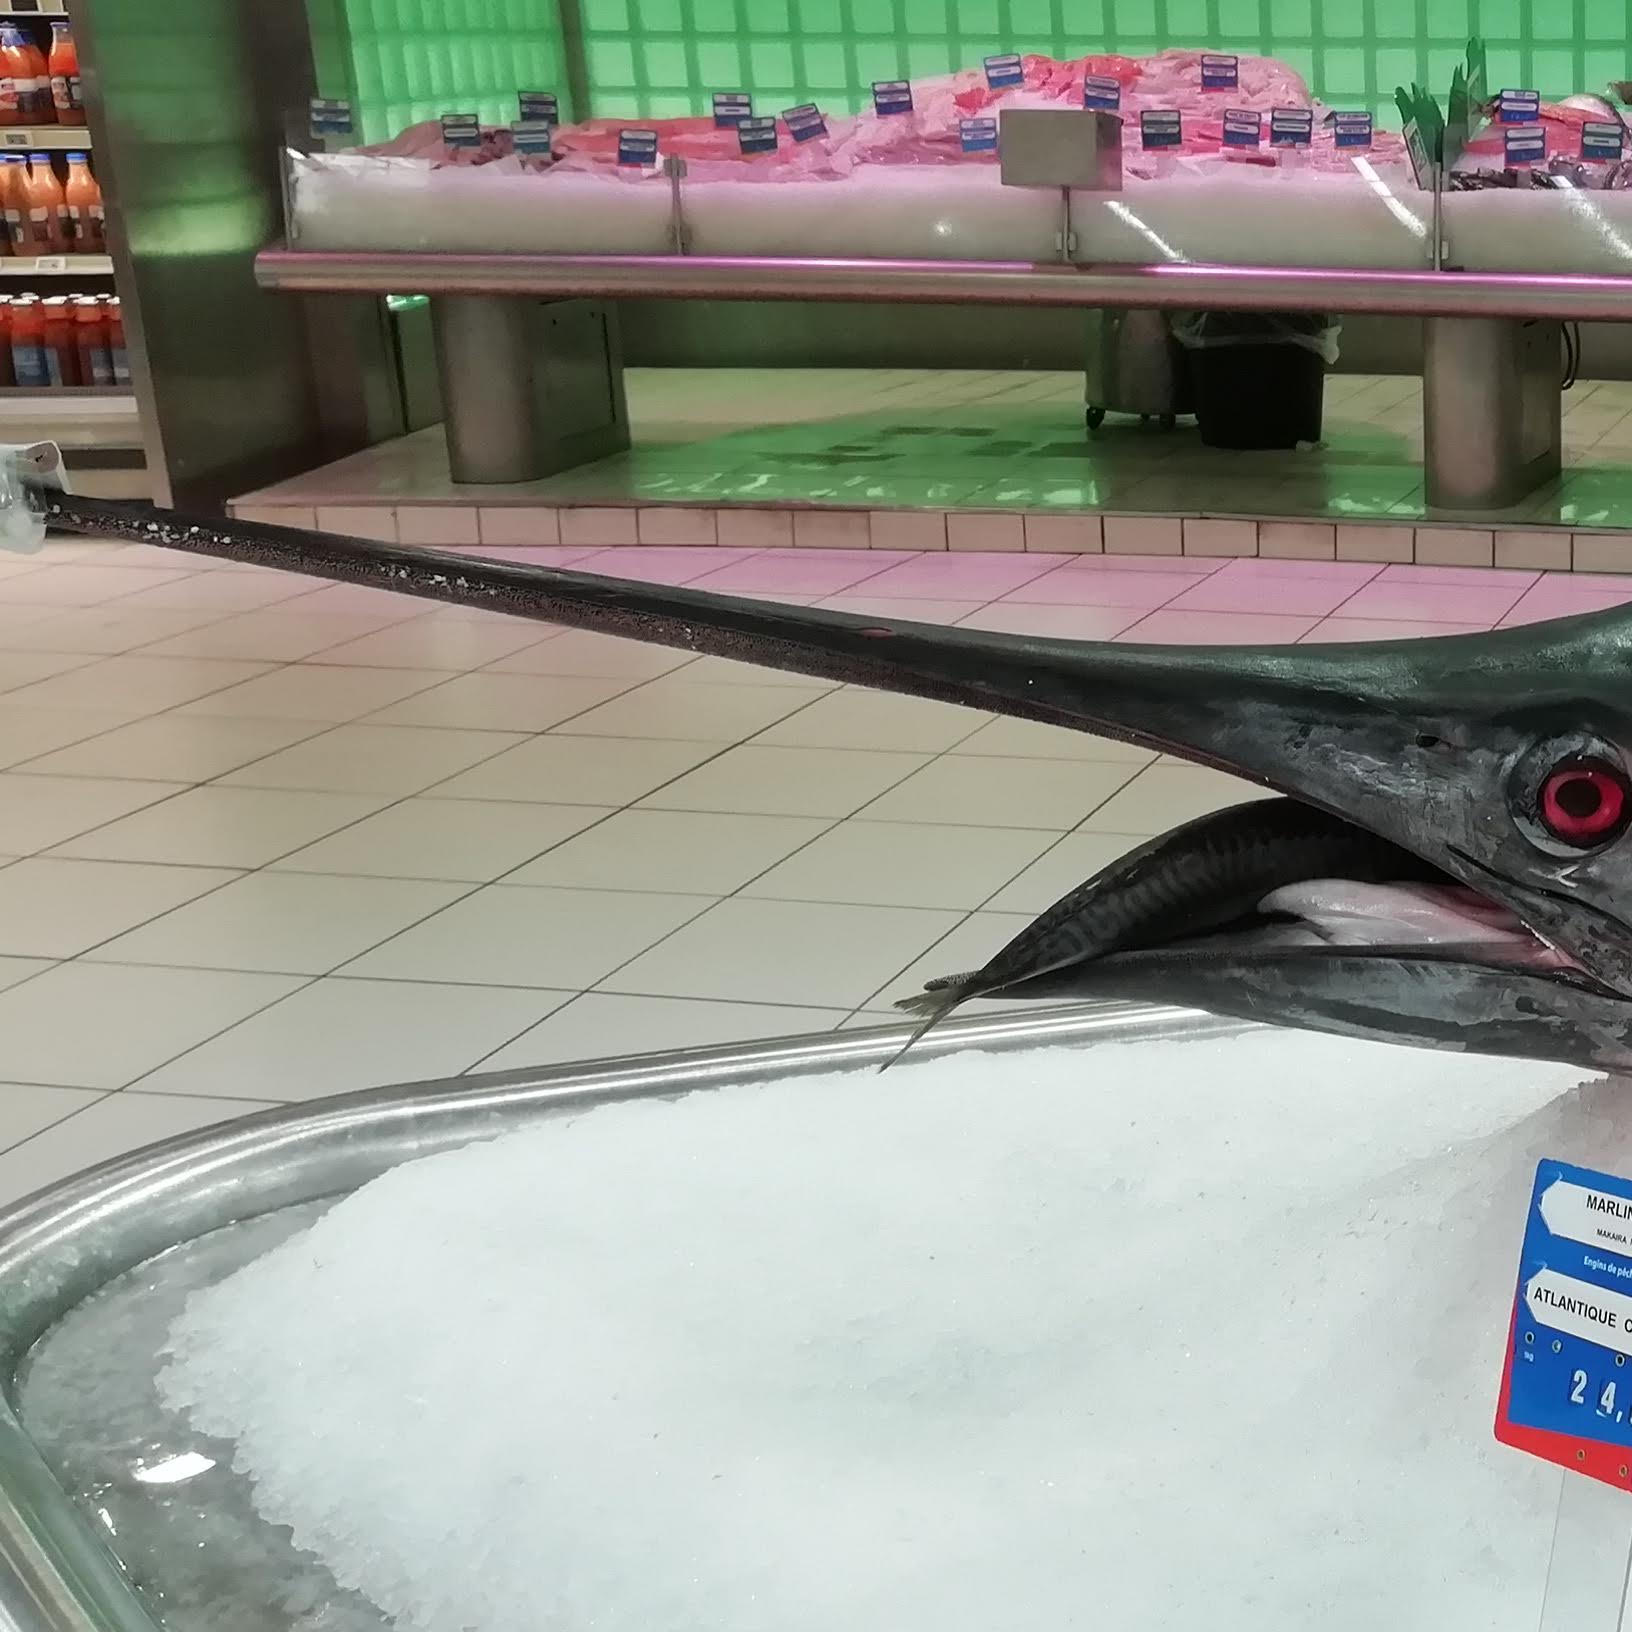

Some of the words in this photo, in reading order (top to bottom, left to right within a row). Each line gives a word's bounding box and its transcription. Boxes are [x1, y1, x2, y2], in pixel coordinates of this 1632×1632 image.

[1596, 1228, 1627, 1244] MAKAIRA
[1584, 1256, 1606, 1271] Engins
[1607, 1263, 1616, 1274] de
[1534, 1287, 1617, 1329] ATLANTIQUE
